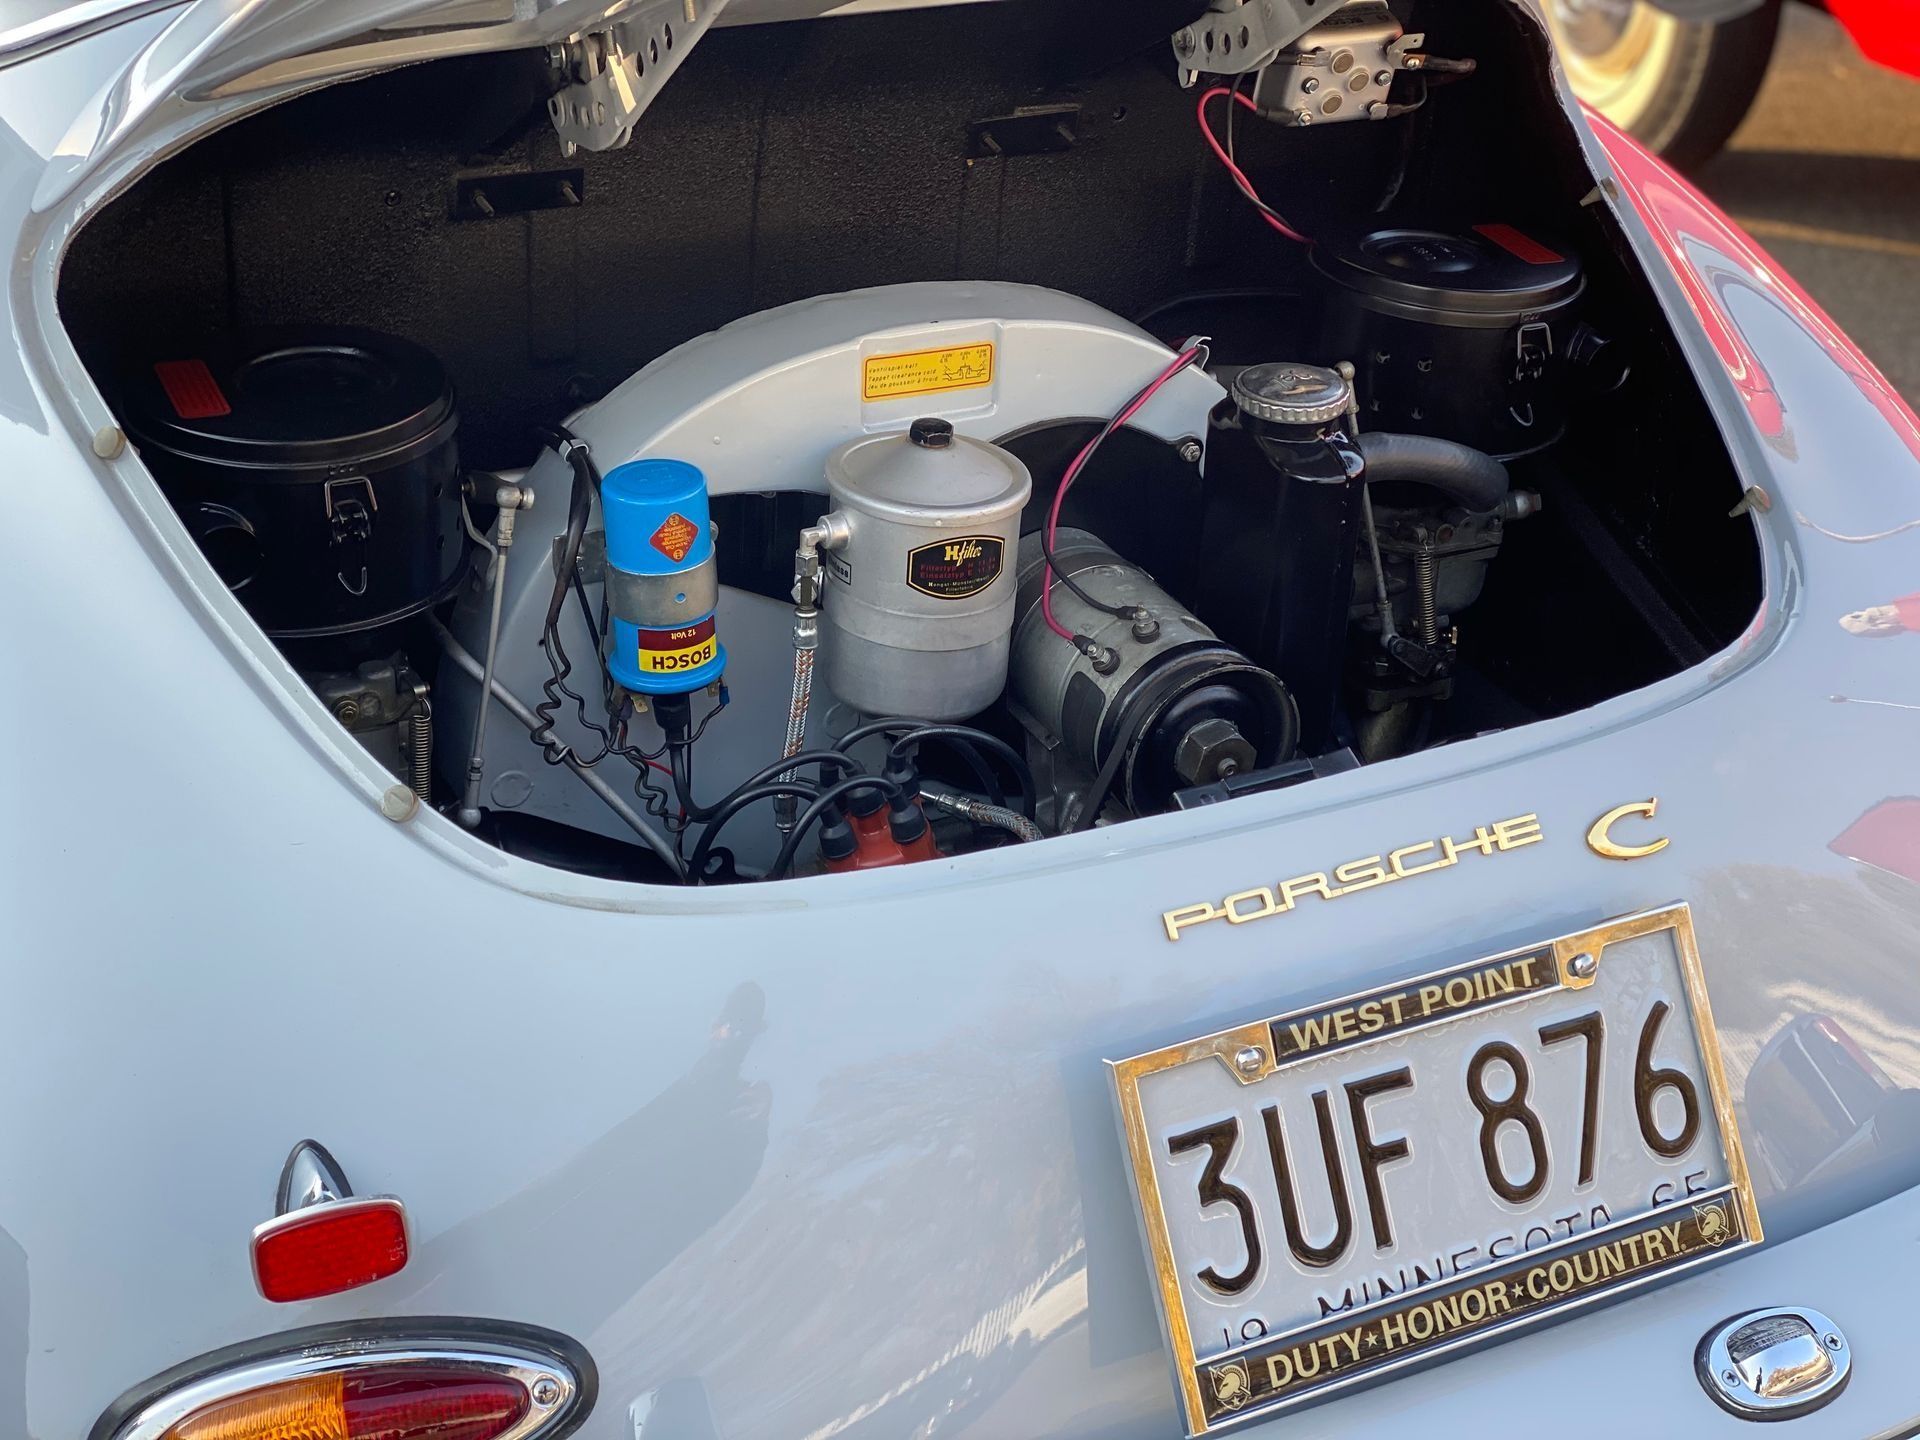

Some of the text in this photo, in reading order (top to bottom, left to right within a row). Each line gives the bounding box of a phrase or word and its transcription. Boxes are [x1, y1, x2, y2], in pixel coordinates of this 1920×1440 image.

[868, 369, 938, 383] Tappet clearance cold
[652, 644, 711, 670] BOSCH
[671, 628, 697, 640] 12 Volt
[1163, 797, 1670, 941] PORSCHE C
[1289, 957, 1537, 1052] WEST POINT
[1168, 999, 1700, 1297] 3UF 876
[1266, 1221, 1682, 1389] DUTY HONOR COUNTRY
